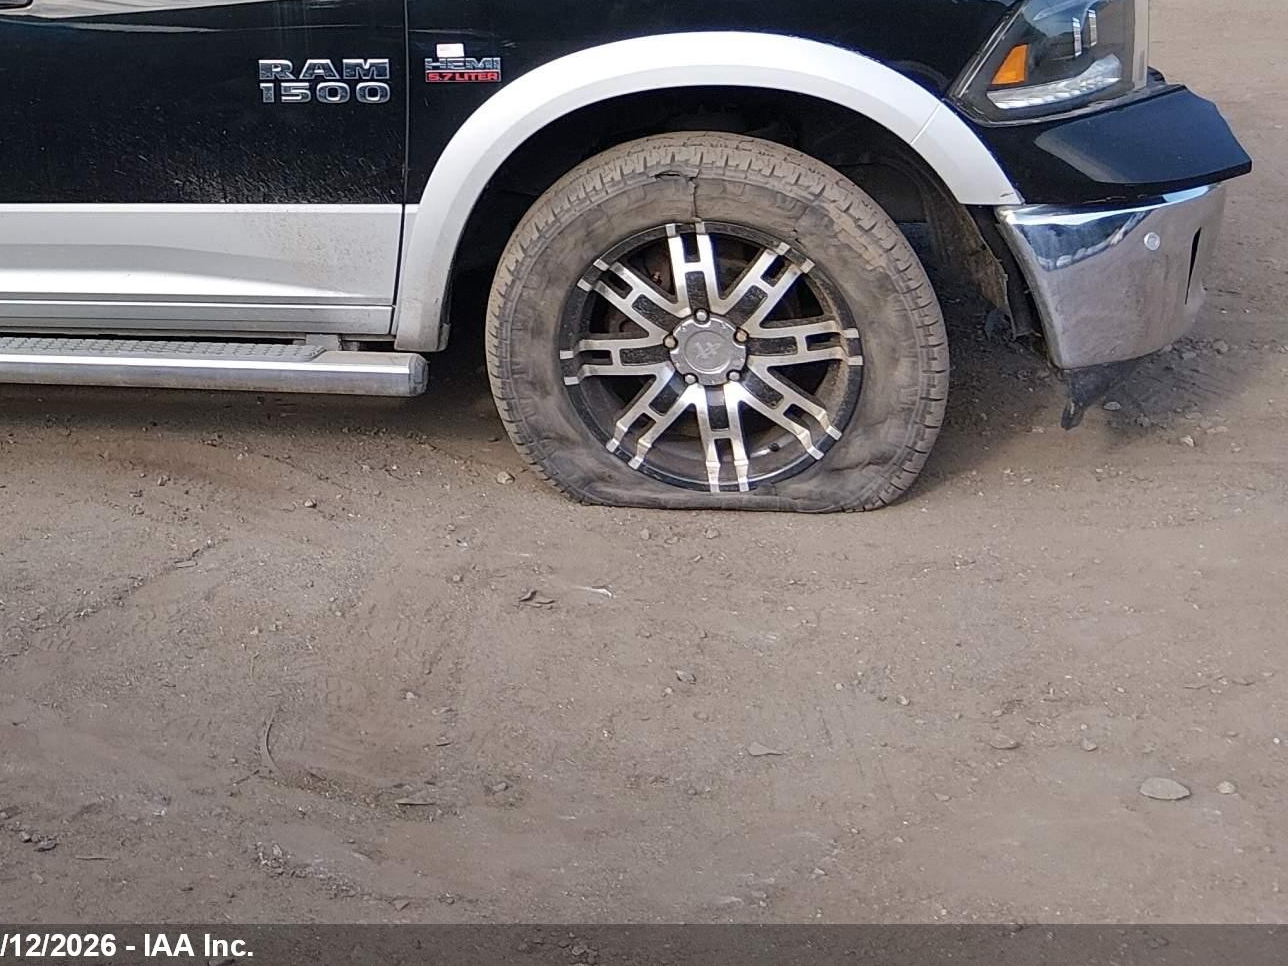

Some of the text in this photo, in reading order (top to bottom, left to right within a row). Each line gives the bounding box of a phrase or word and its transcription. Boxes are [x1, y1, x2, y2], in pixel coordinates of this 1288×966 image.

[258, 59, 390, 80] RAM
[425, 58, 501, 70] HEMI
[428, 73, 498, 82] 5.7 LITER
[259, 81, 391, 104] 1500
